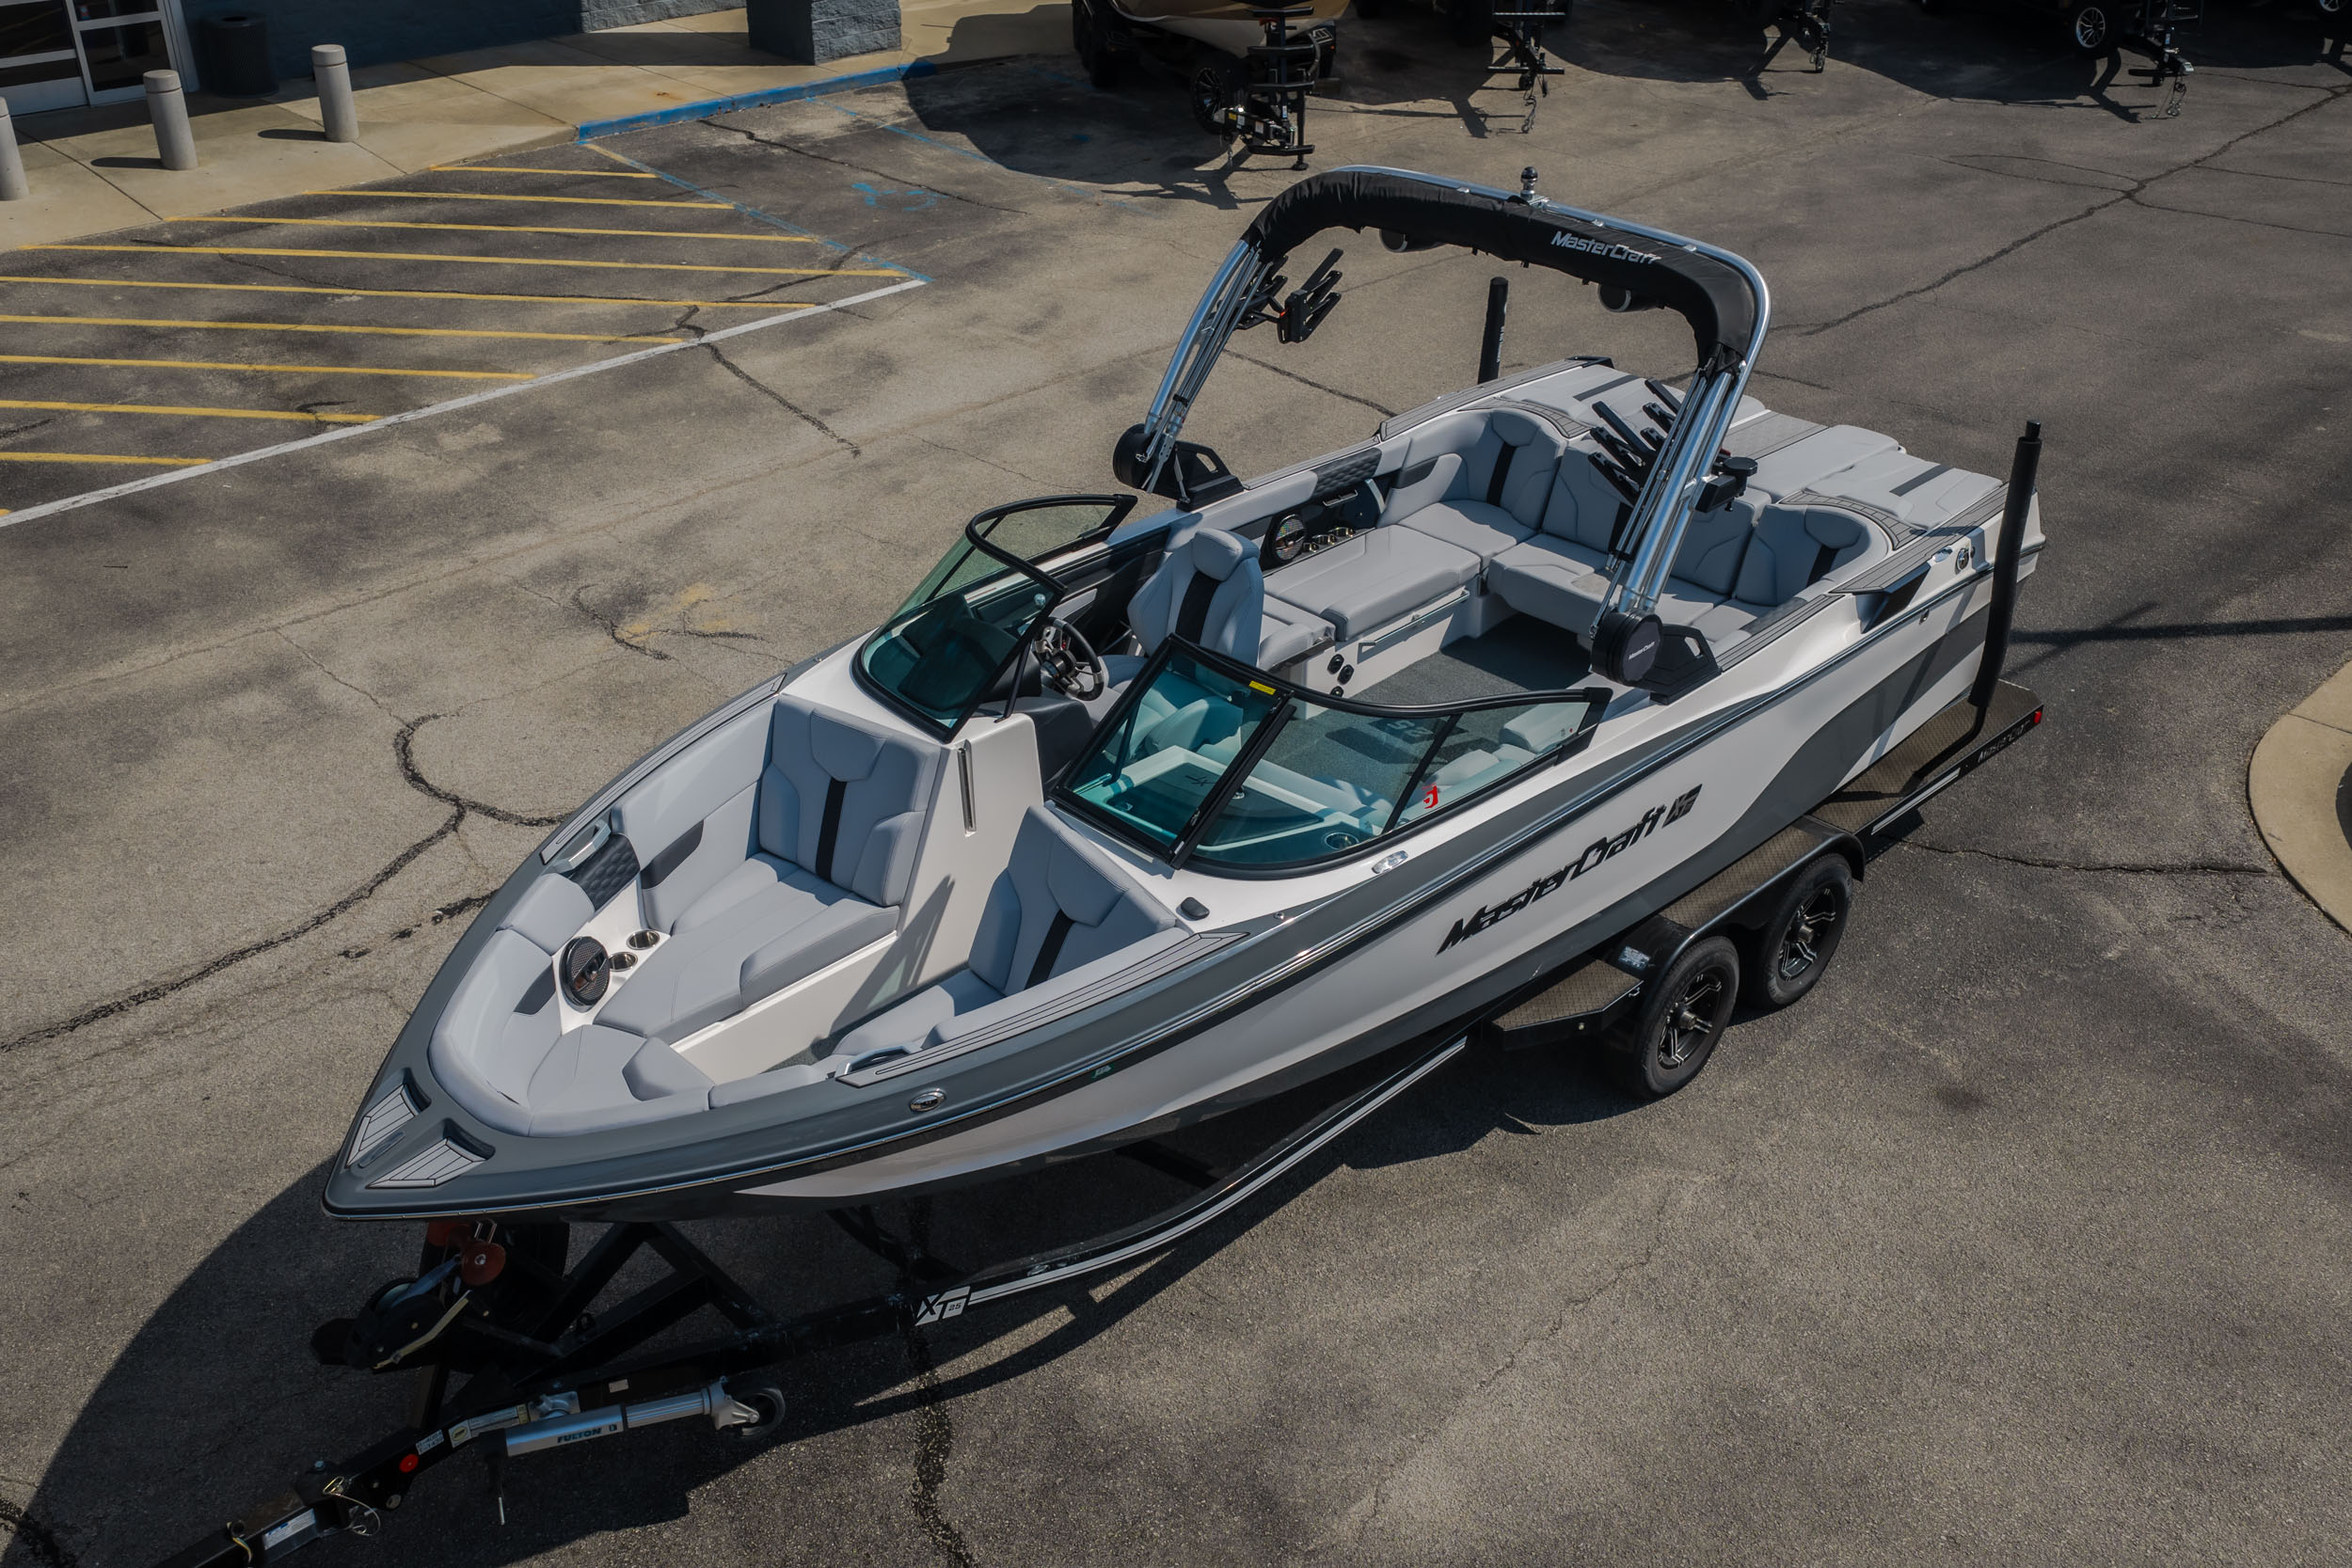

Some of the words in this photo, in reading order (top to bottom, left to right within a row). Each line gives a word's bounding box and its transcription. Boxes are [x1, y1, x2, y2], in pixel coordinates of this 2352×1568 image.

[1550, 230, 1661, 264] MasterCraft
[1435, 804, 1667, 957] MasterCraft
[557, 1428, 602, 1444] FULTON
